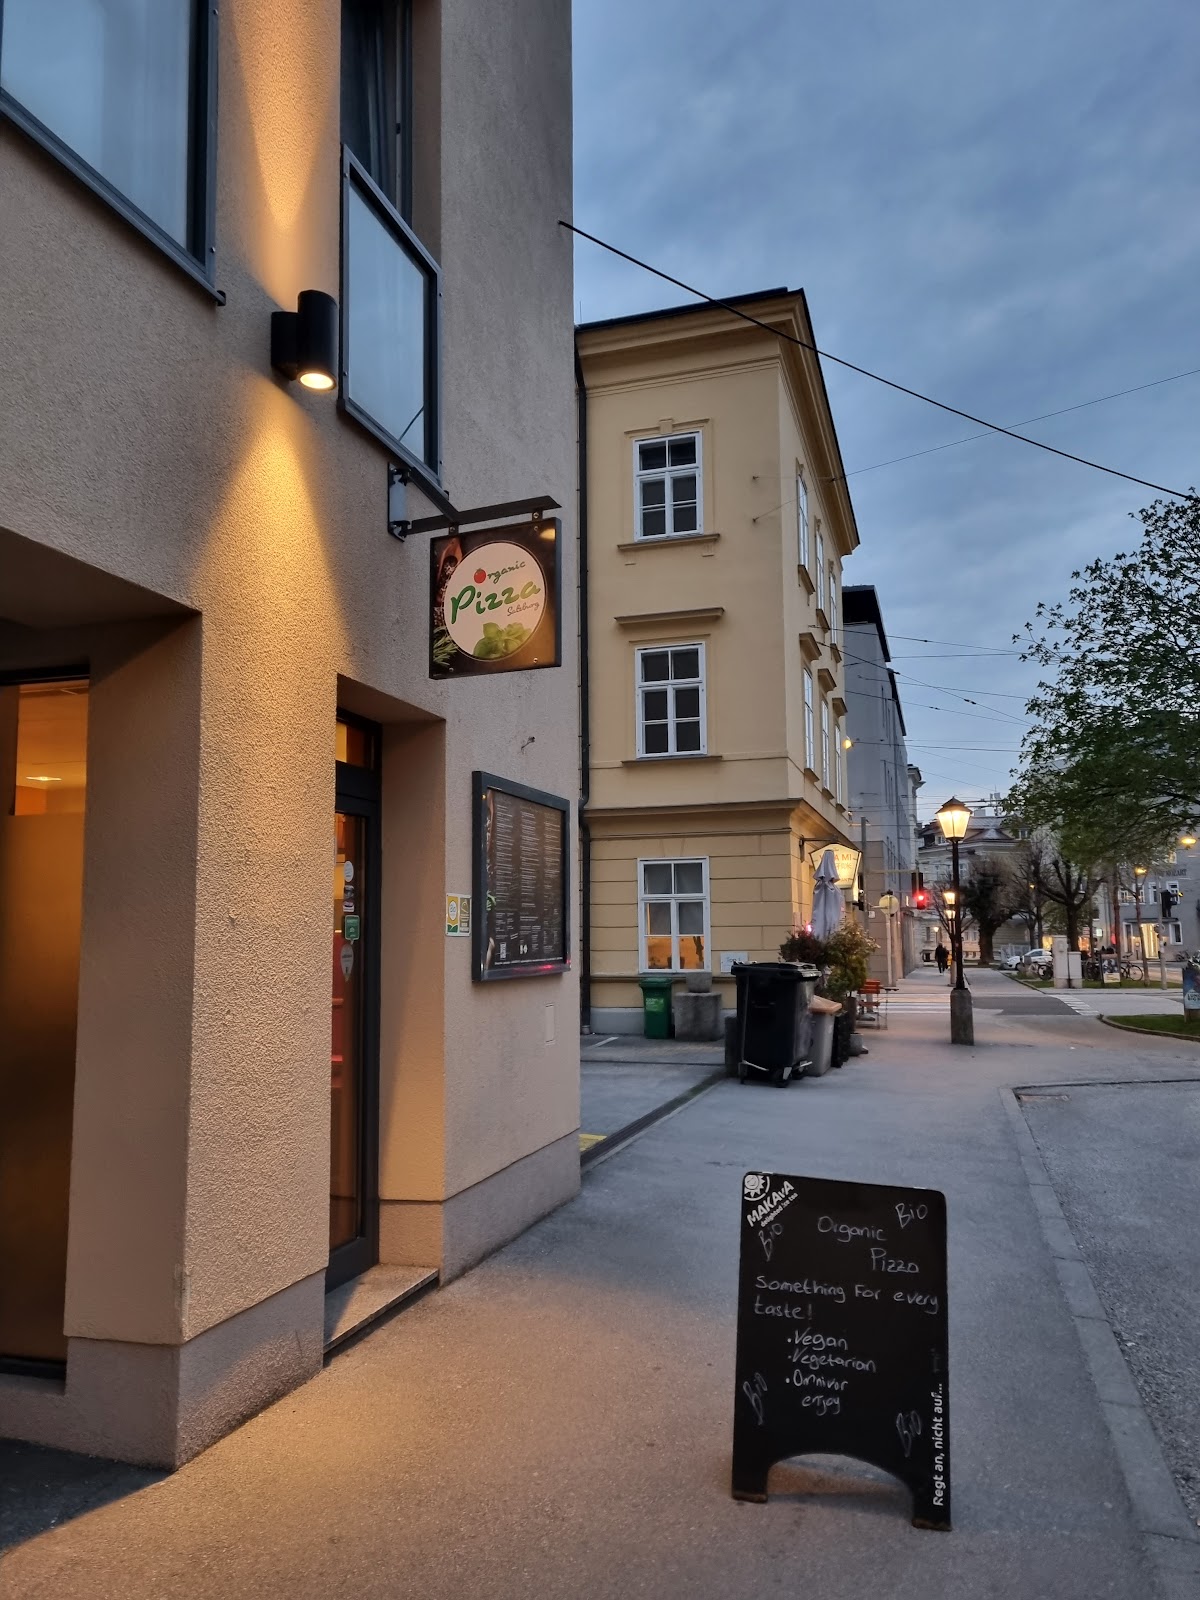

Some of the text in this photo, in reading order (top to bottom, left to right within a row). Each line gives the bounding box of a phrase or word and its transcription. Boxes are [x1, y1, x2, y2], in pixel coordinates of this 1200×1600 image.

[451, 581, 541, 624] Pizza
[761, 1205, 783, 1227] delighted
[817, 1216, 887, 1242] Organic
[871, 1248, 919, 1273] Pizza
[755, 1275, 845, 1304] Something
[893, 1291, 939, 1314] every
[754, 1296, 812, 1320] taste!
[795, 1327, 848, 1350] Vegan
[792, 1348, 876, 1373] Vegetarian
[793, 1369, 848, 1390] Omnivor
[802, 1395, 840, 1416] enjoy
[930, 1383, 946, 1506] Regt an, nicht auf...
